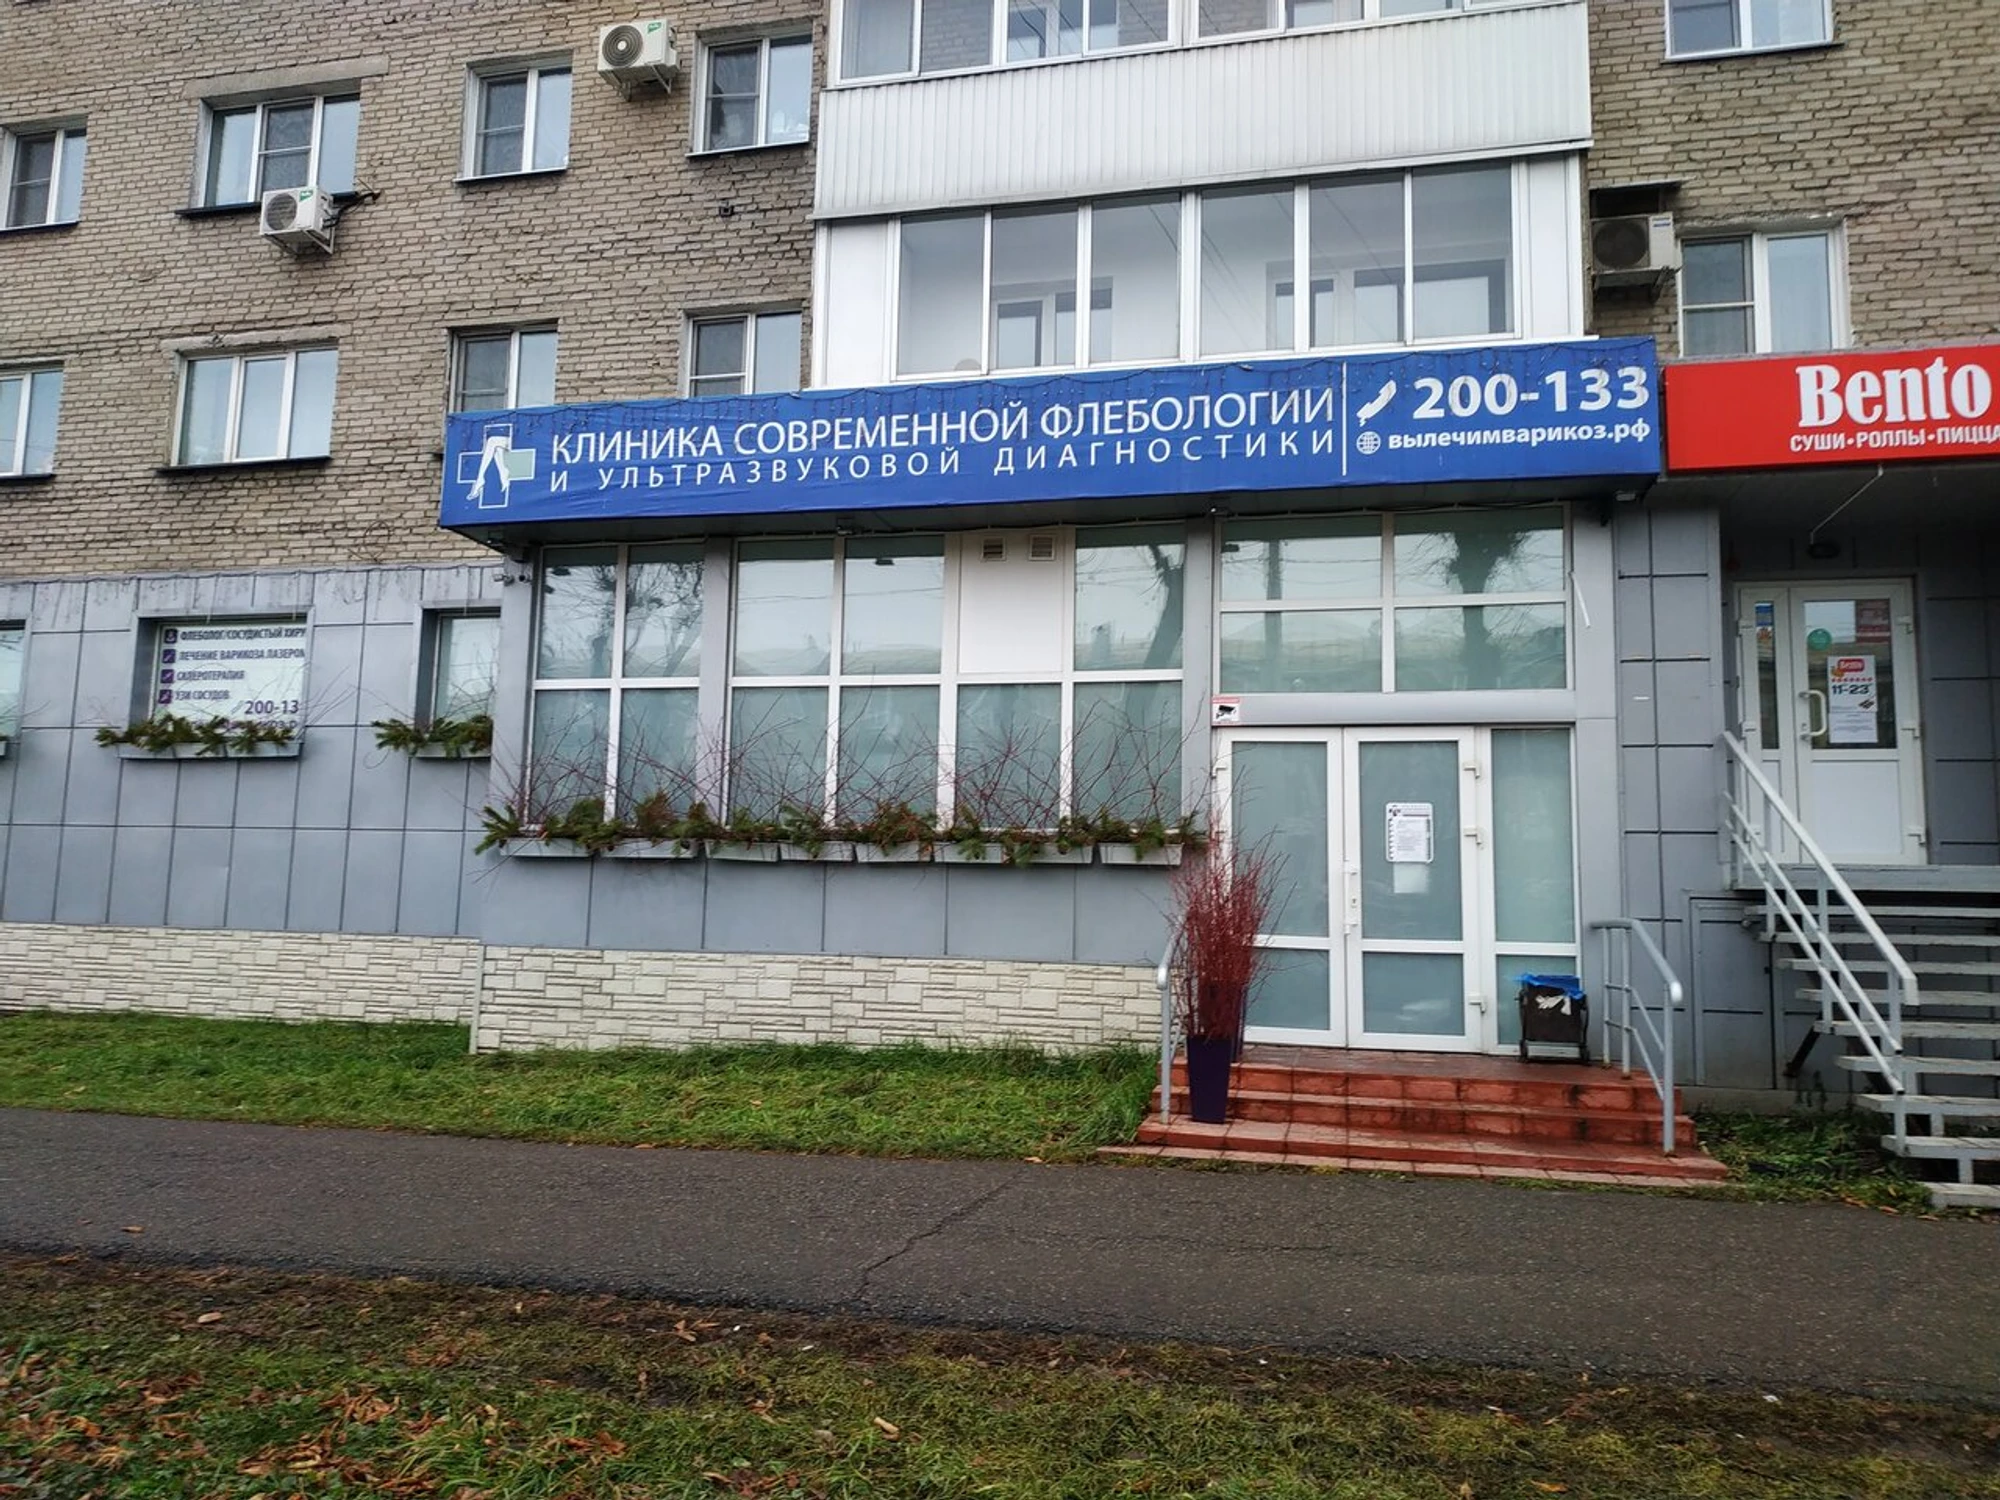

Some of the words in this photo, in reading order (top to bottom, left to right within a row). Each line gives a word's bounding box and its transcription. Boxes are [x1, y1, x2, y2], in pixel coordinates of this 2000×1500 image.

[1412, 366, 1650, 420] 200-133
[1795, 356, 1993, 428] Bento
[550, 425, 724, 465] КЛИНИКА
[733, 401, 1028, 456] СОВРЕМЕННОЙ
[1040, 387, 1334, 440] ФЛЕБОЛОГИИ
[1388, 417, 1651, 450] вылечимварикоз.рф
[1790, 432, 1846, 453] СУШИ
[1856, 428, 1926, 449] РОЛЛЫ
[1937, 424, 2000, 445] ПИЦЦА
[550, 470, 568, 492] И
[598, 450, 961, 490] УЛЬТРАЗВУКОВОЙ
[993, 429, 1334, 476] ДИАГНОСТИКИ
[244, 700, 299, 714] 200-13
